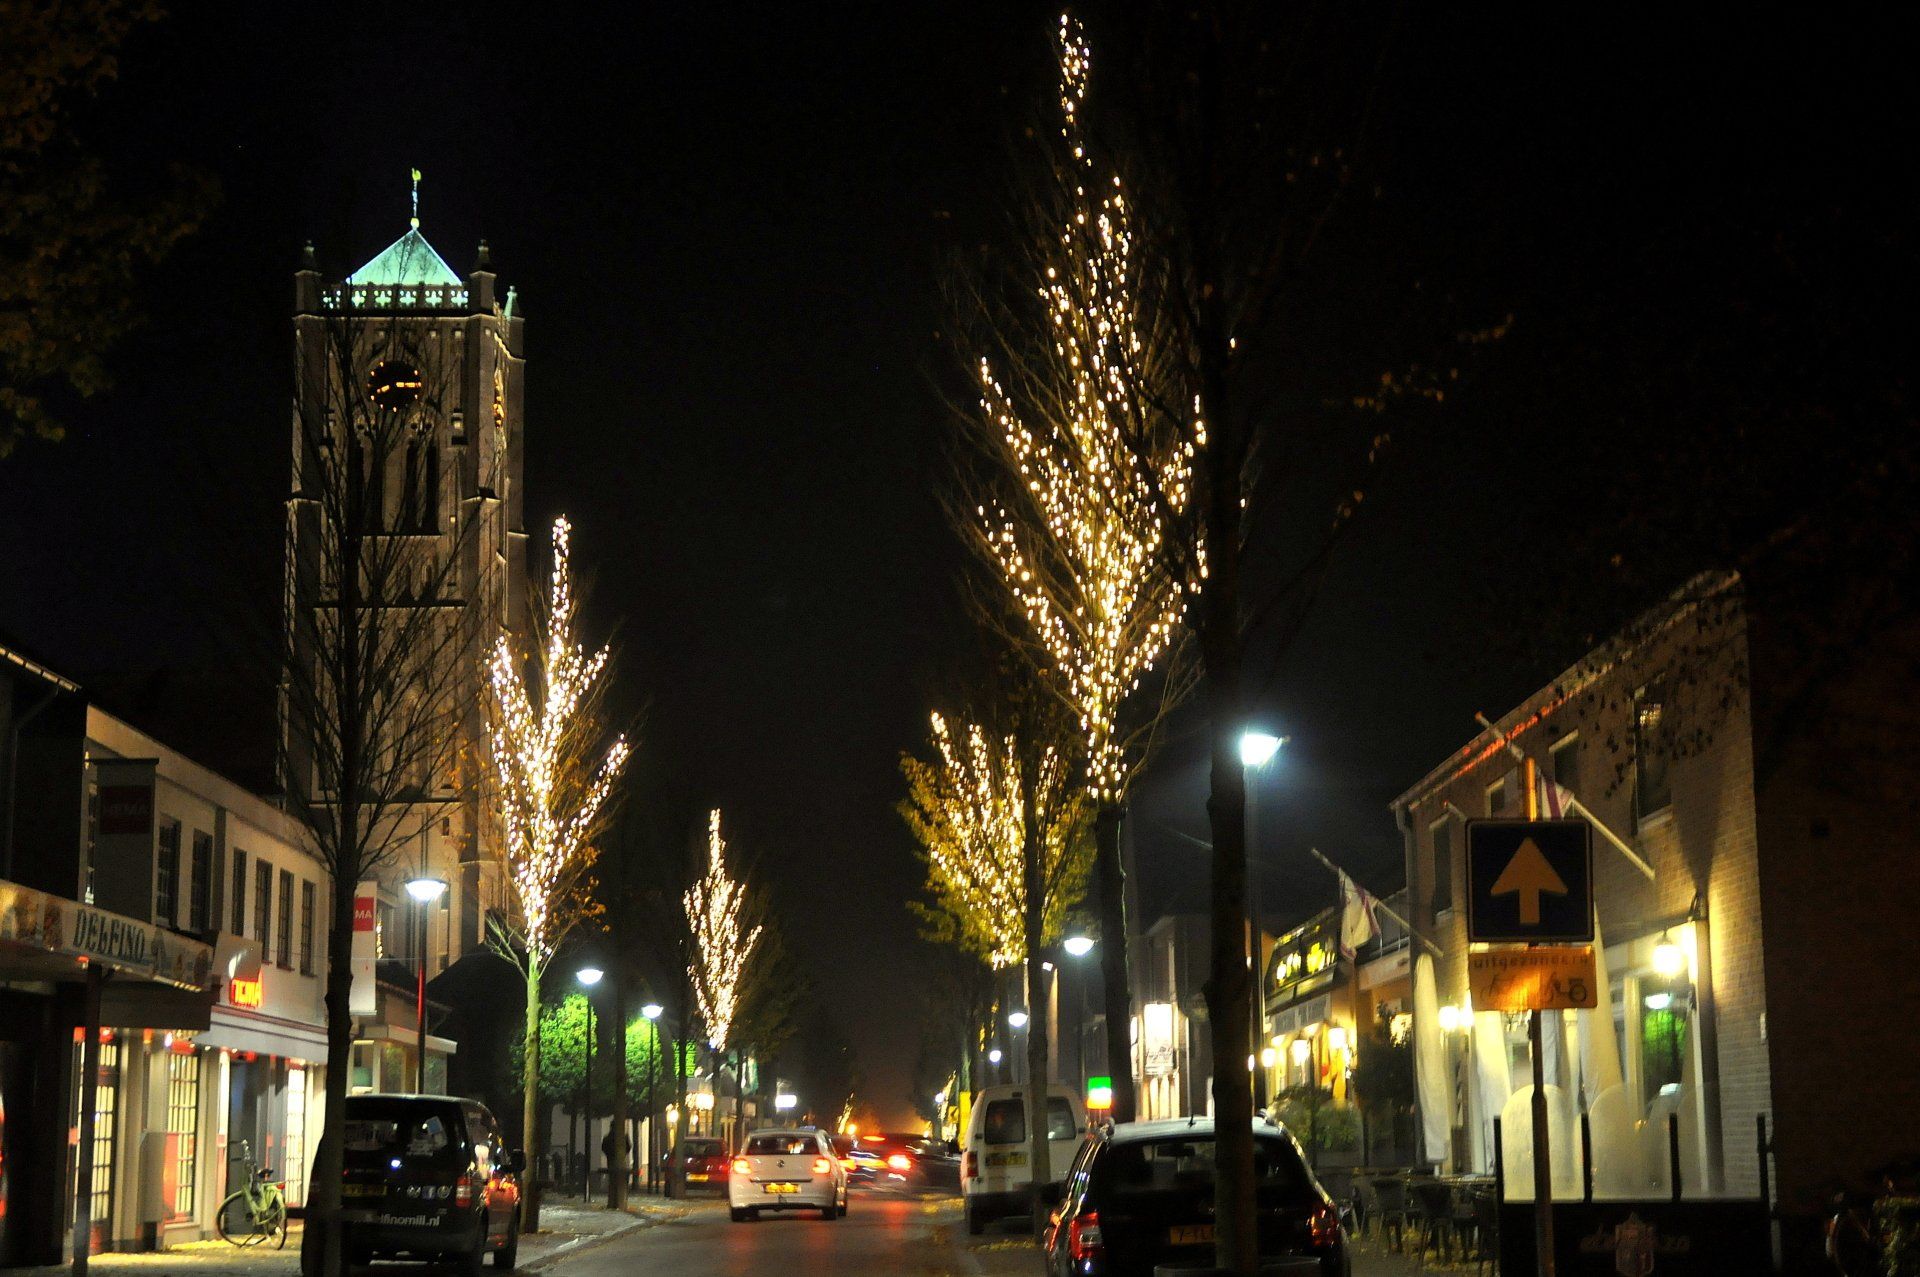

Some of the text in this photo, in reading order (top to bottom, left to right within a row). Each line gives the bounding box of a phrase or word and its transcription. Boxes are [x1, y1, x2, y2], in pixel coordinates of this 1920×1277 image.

[354, 909, 373, 920] MA
[73, 908, 146, 963] DELFINO
[380, 1213, 440, 1227] lfinomill.nl
